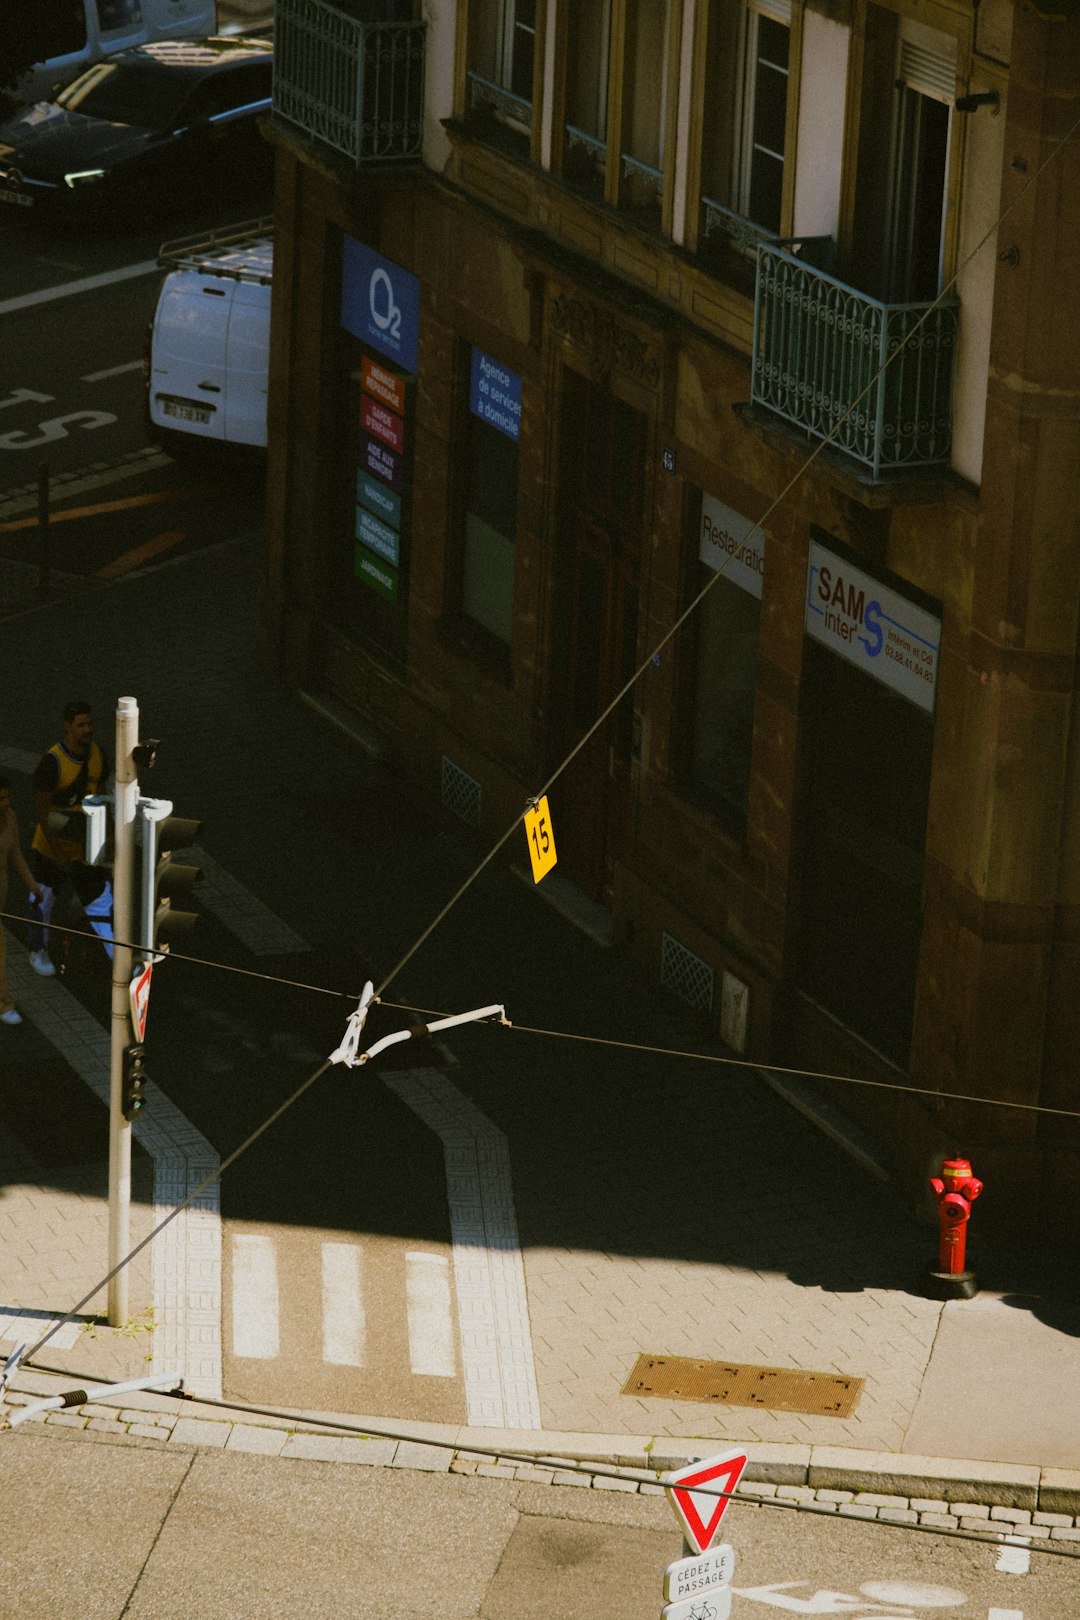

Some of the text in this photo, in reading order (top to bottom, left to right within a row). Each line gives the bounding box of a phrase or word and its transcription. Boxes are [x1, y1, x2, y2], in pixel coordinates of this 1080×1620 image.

[480, 355, 510, 387] Agence
[478, 377, 489, 395] de
[365, 414, 397, 445] D'ENFANTS
[371, 405, 392, 428] GARDE
[477, 397, 518, 436] à domicile
[367, 441, 394, 469] AIDE AUX
[912, 647, 919, 658] et
[532, 817, 550, 860] 15
[678, 1556, 726, 1582] CÉDEZ LE
[678, 1571, 725, 1595] PASSAGE
